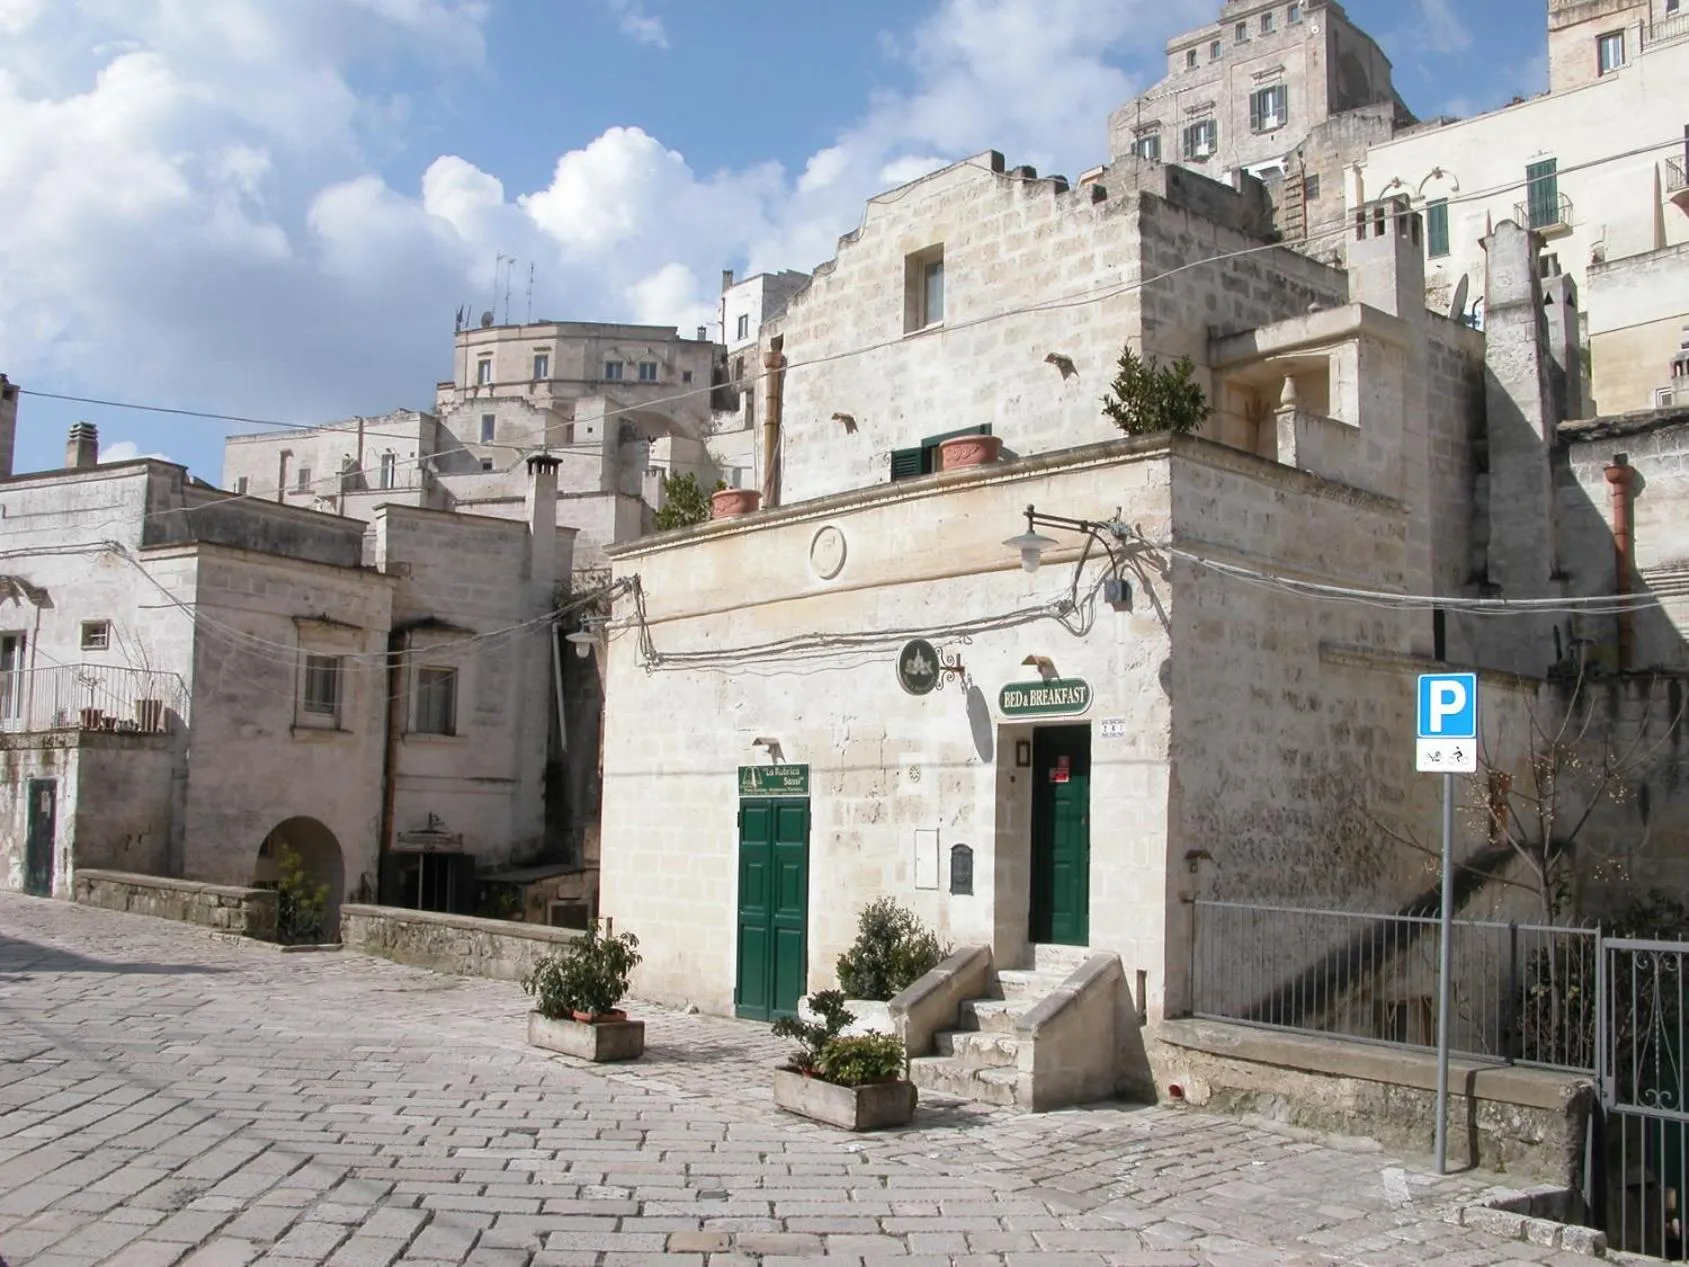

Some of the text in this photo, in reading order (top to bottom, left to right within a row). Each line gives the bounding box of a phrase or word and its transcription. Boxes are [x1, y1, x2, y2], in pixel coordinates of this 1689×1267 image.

[1004, 686, 1086, 708] BED & BREAKFAST
[1430, 680, 1466, 732] P
